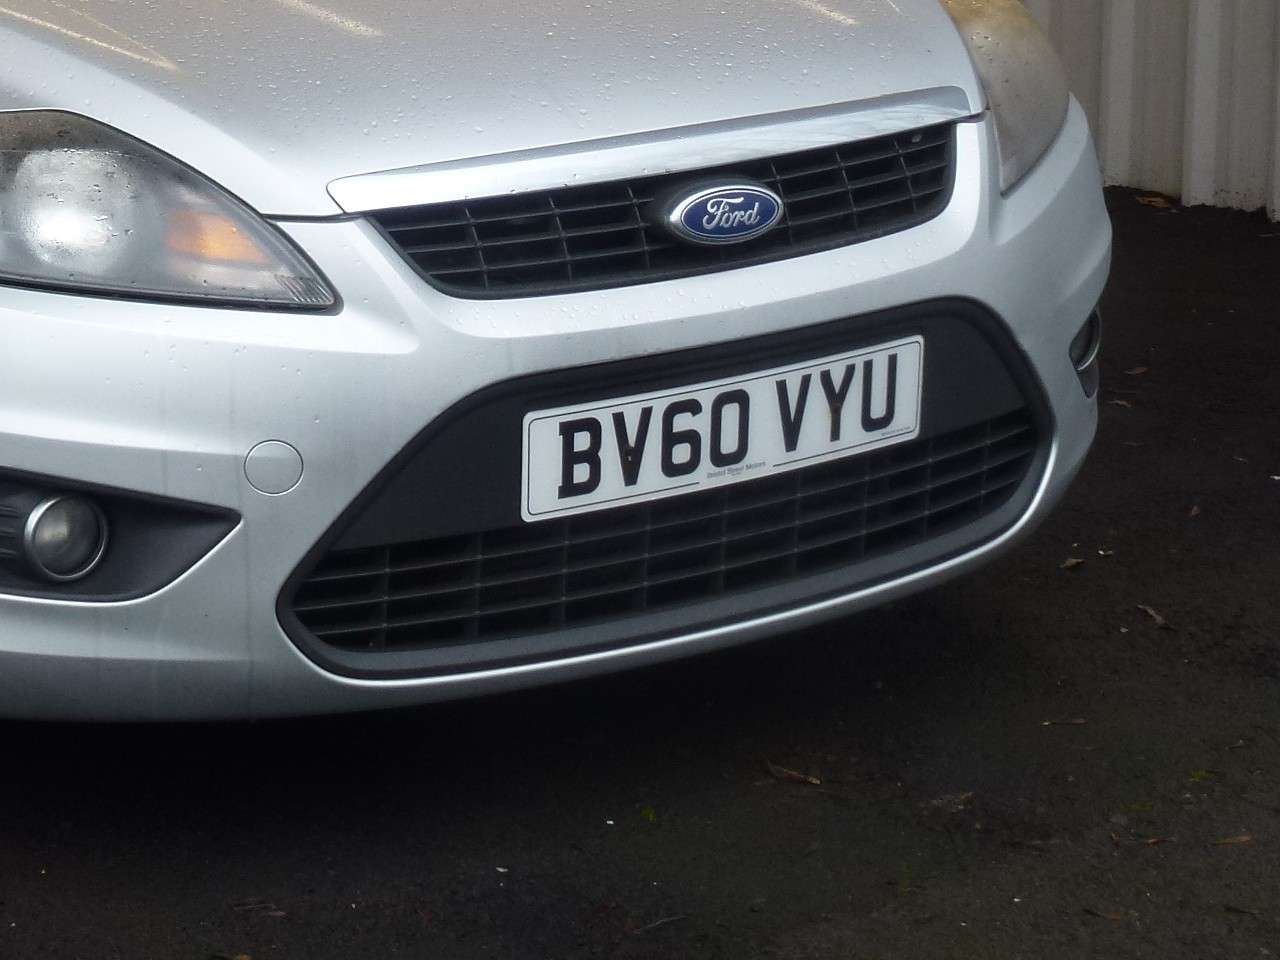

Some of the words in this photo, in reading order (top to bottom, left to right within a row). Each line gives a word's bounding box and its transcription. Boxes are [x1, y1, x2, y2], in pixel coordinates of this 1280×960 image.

[702, 197, 760, 230] Ford
[557, 388, 750, 500] BV60
[775, 352, 898, 453] VYU
